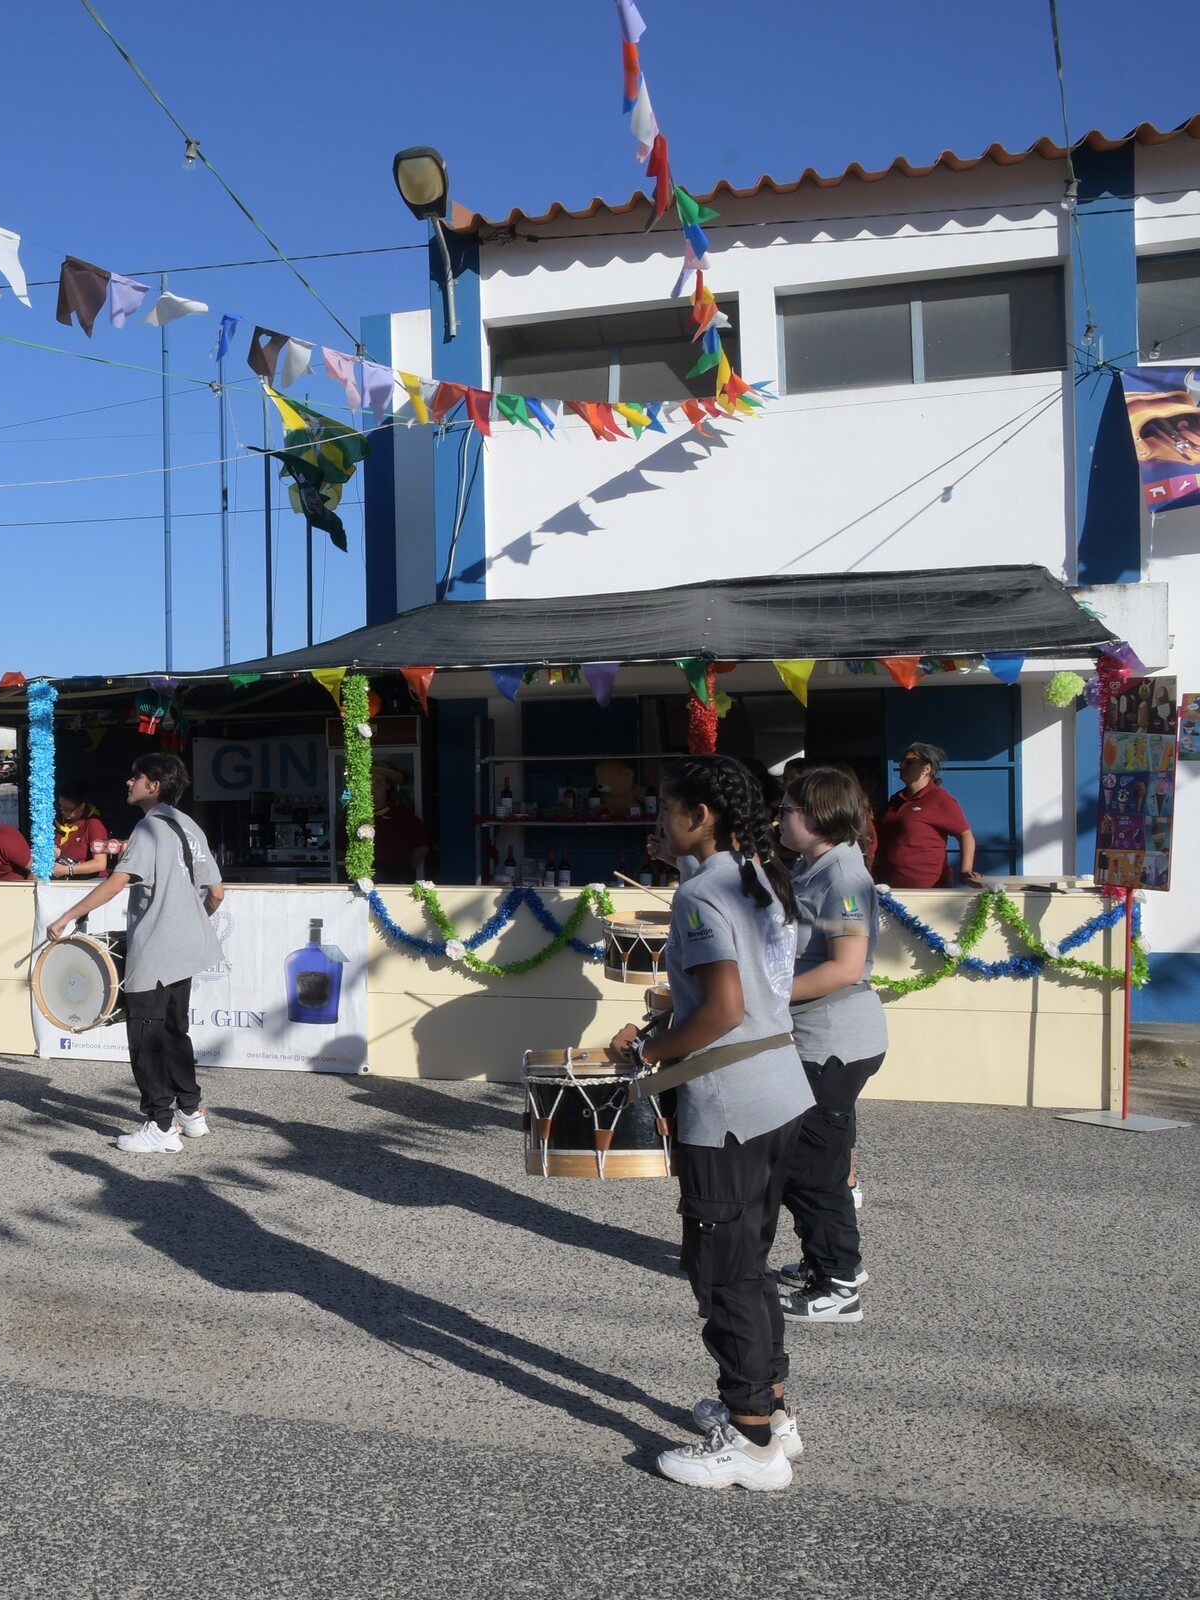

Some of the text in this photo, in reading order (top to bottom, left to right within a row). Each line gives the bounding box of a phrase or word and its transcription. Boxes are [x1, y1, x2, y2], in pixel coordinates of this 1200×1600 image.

[212, 742, 328, 790] GIN
[211, 1009, 266, 1029] GIN
[72, 1042, 129, 1051] facebook.com/rea
[194, 1049, 220, 1057] algin.pt
[715, 1455, 732, 1464] FILA
